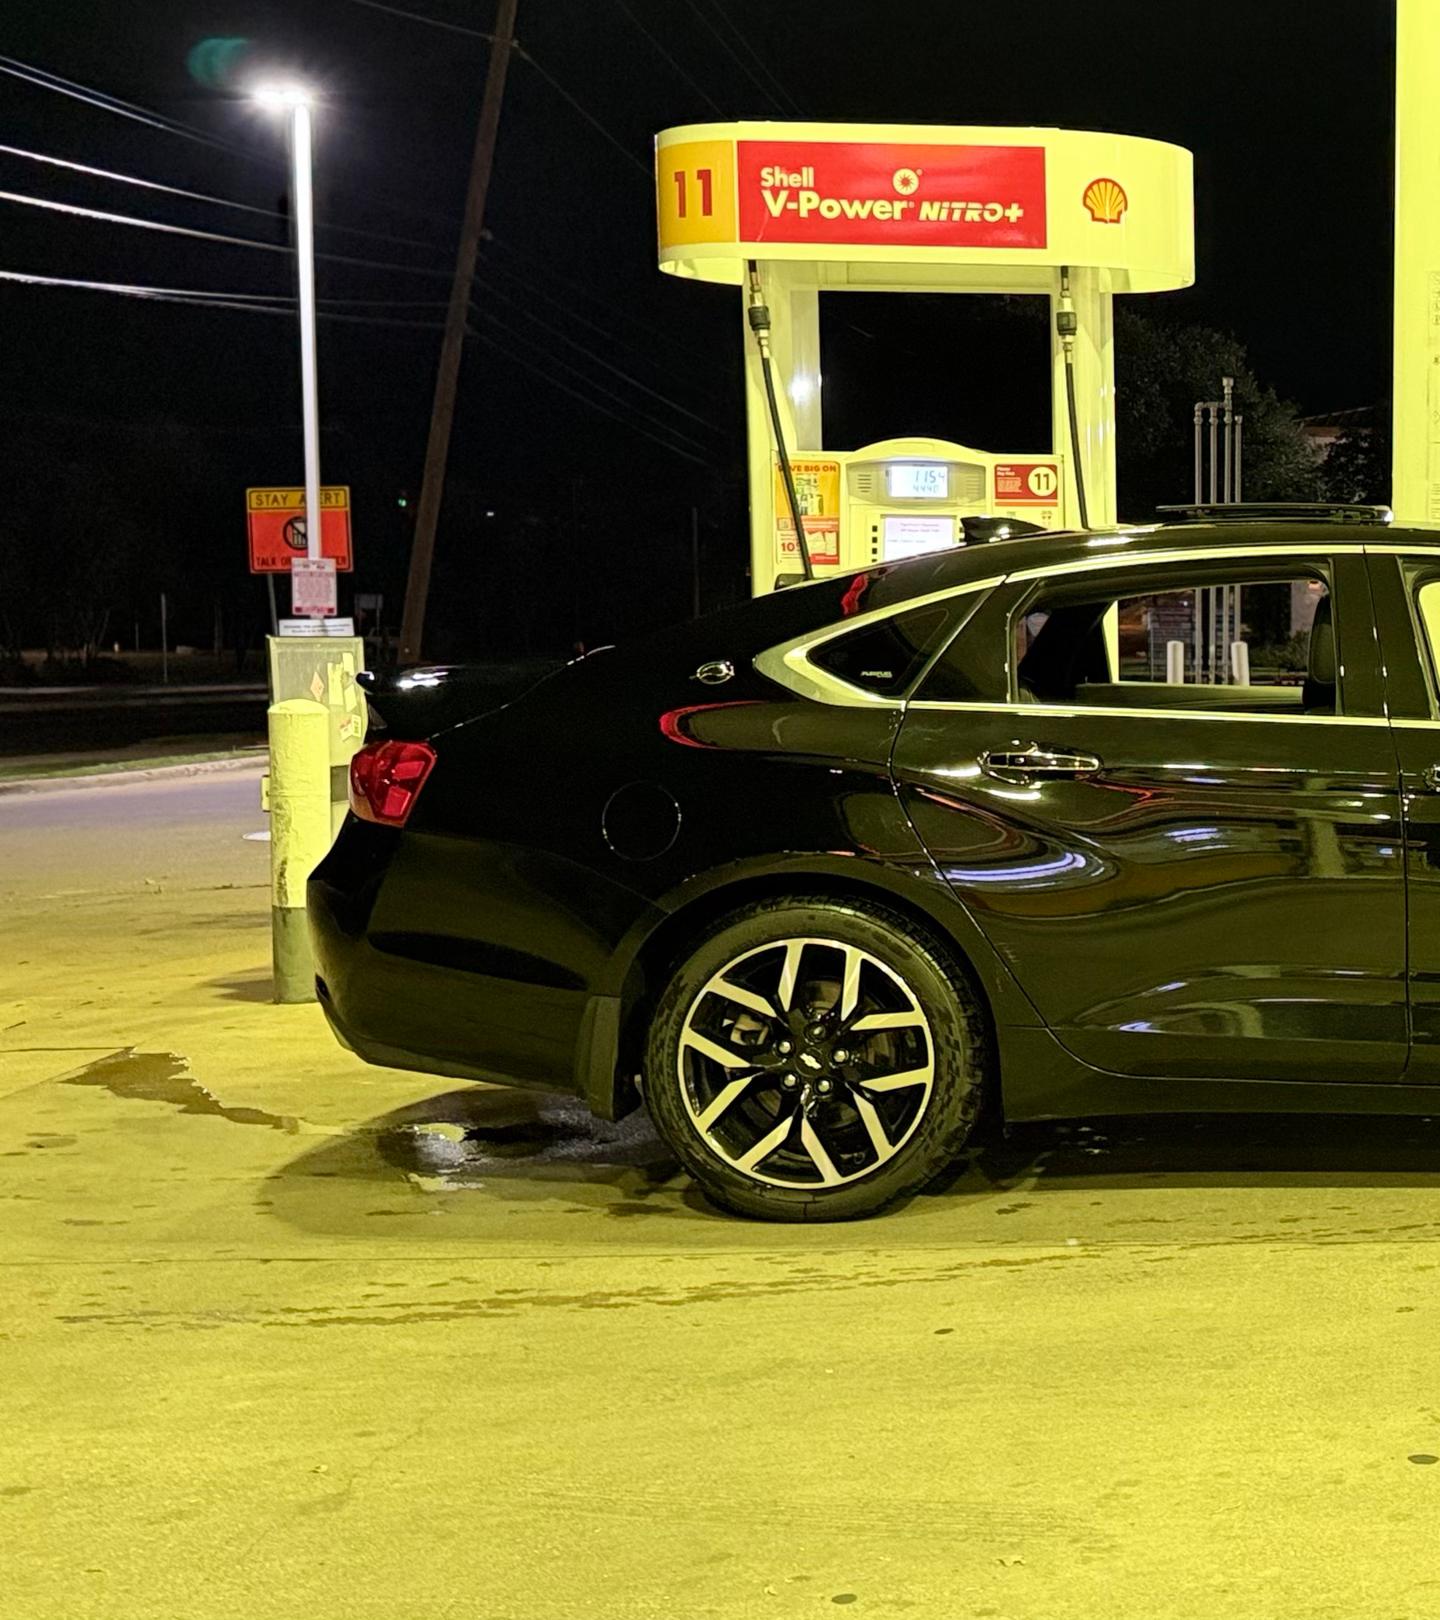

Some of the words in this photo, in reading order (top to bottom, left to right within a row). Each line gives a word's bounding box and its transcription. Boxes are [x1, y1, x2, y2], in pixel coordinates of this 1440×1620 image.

[760, 166, 815, 187] Shell
[674, 169, 712, 218] 11
[822, 464, 837, 473] ON
[1034, 473, 1050, 491] 11
[255, 494, 289, 506] STAY
[299, 492, 340, 506] AERT
